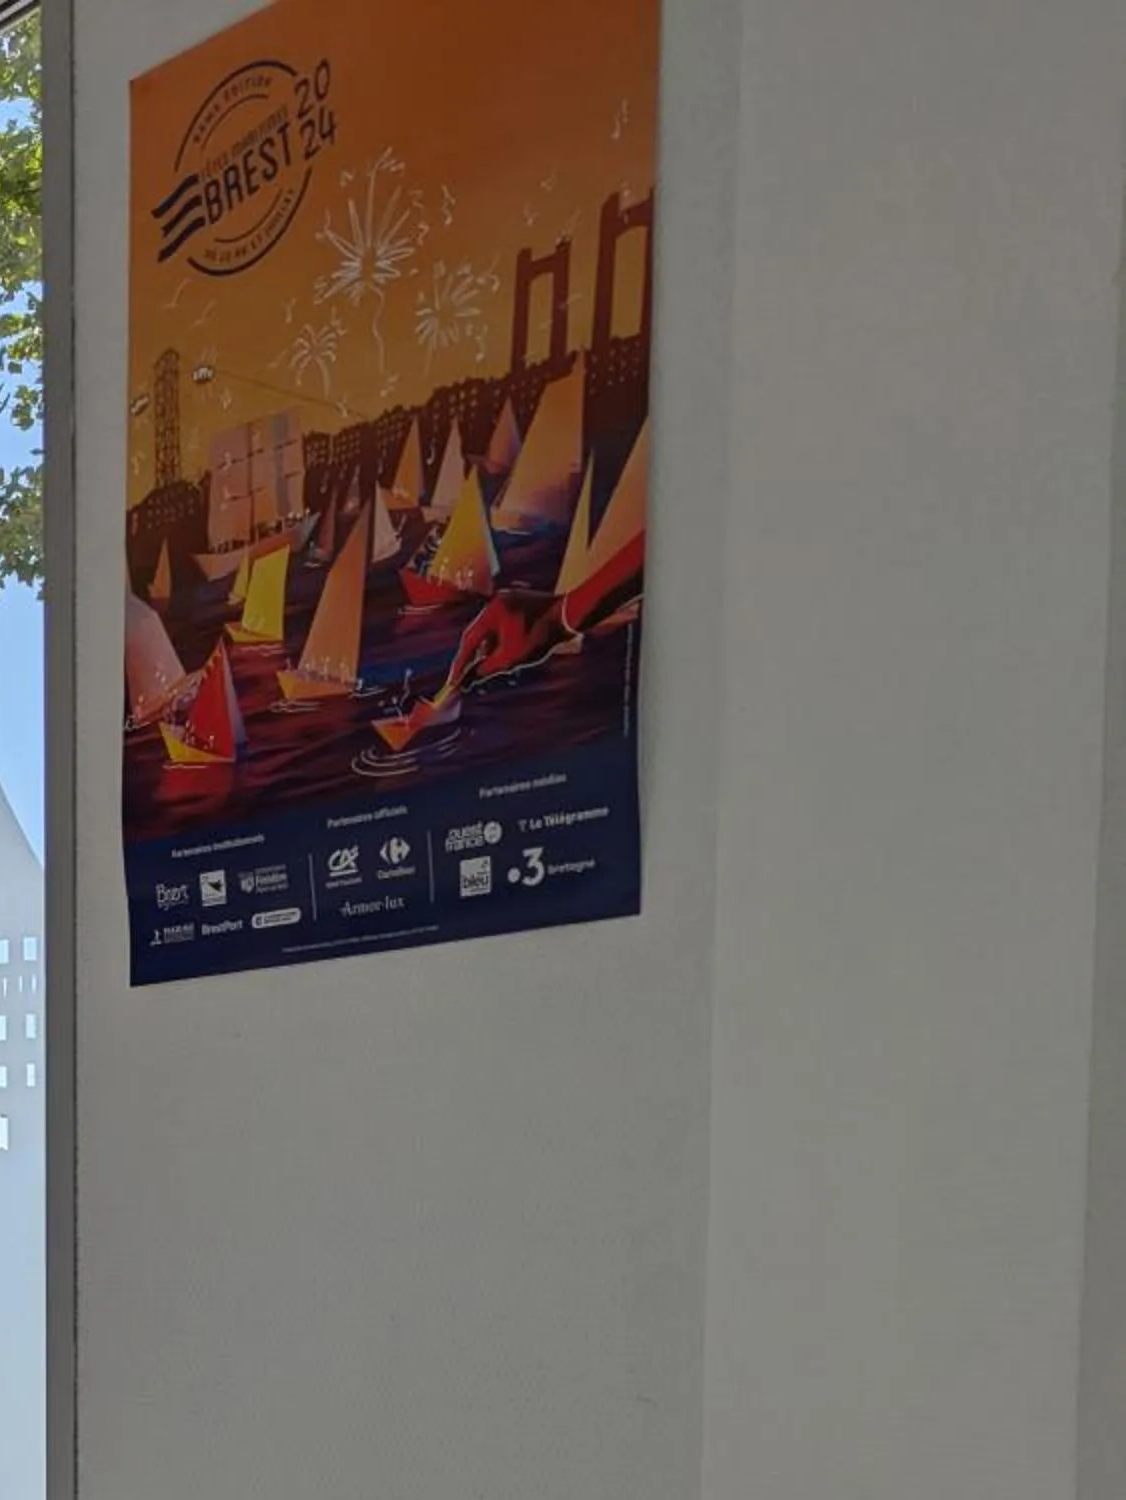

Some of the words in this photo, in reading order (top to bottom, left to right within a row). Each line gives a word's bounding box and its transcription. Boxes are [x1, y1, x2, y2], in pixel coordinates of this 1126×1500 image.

[294, 58, 331, 120] 20
[300, 105, 338, 161] 24
[203, 120, 292, 225] BREST
[543, 806, 610, 828] Télégramme
